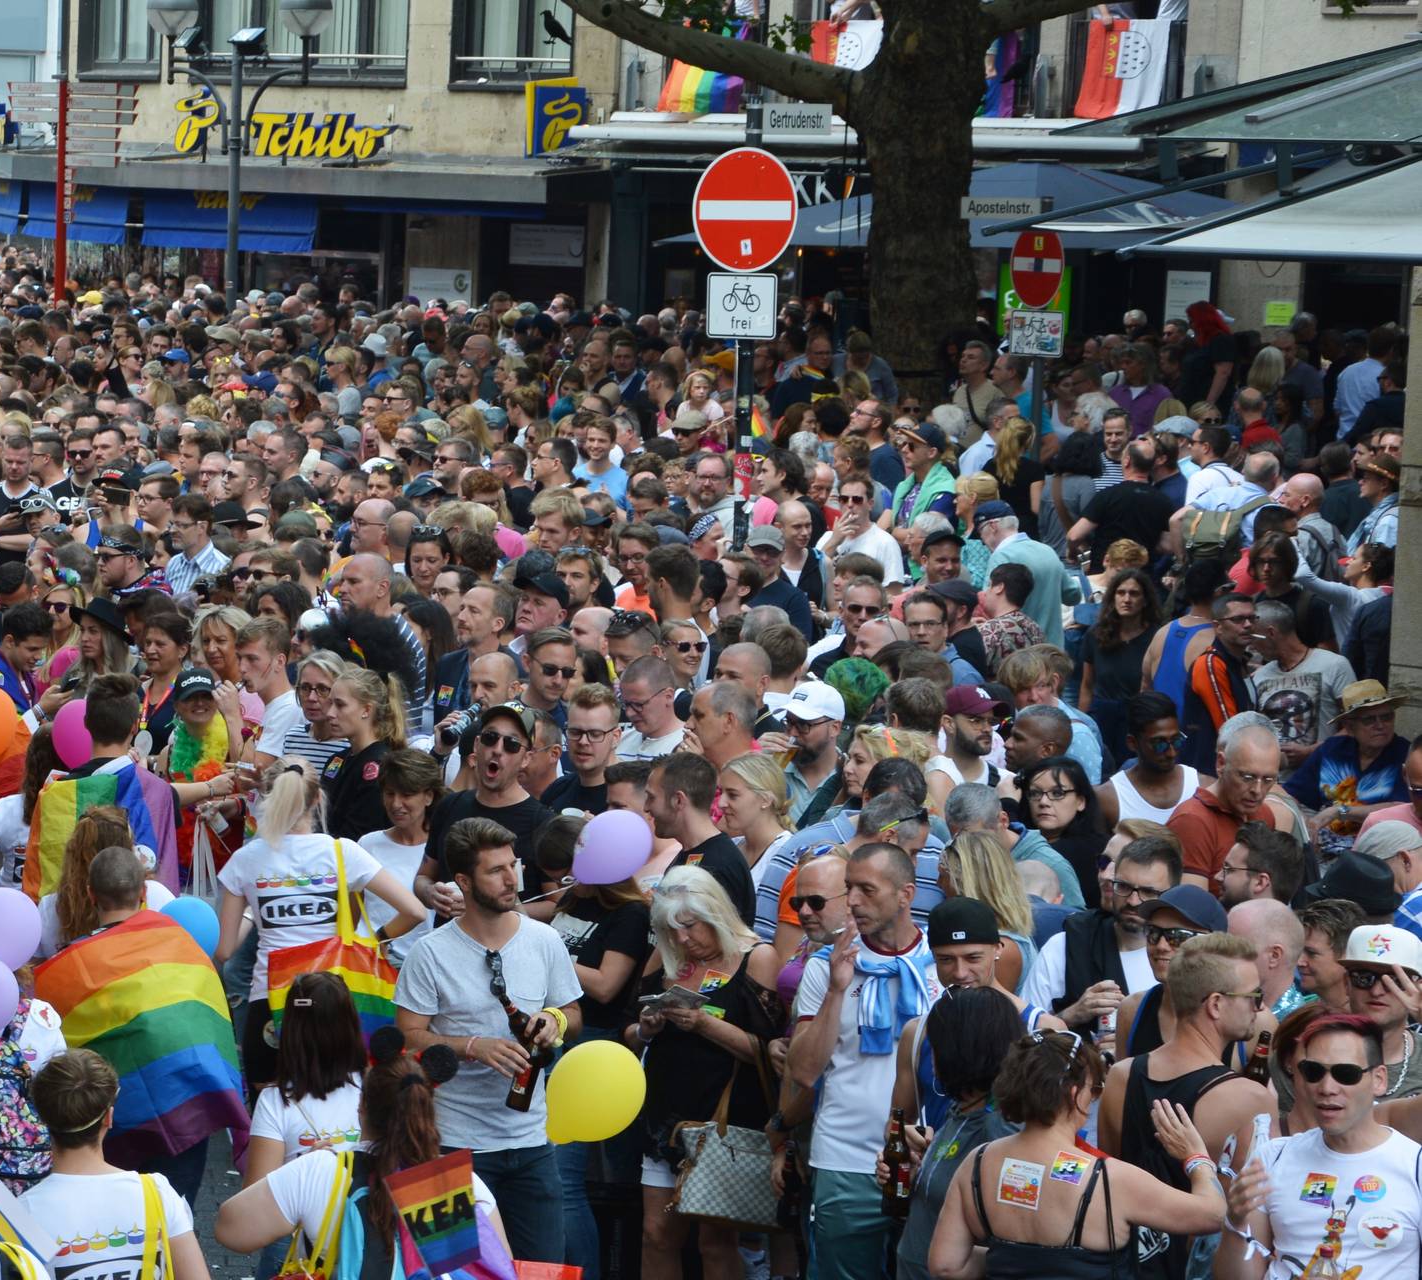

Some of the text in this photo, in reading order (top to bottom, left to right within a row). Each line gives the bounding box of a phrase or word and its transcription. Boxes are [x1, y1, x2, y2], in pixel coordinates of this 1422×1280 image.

[770, 110, 825, 129] Gertrudenstr.
[250, 111, 390, 159] Tchibo
[967, 200, 1033, 215] Apostelnstr.
[731, 316, 751, 329] frei
[56, 496, 83, 511] GE
[181, 675, 212, 688] adidas
[266, 901, 335, 919] IKEA
[1059, 1160, 1077, 1173] FC
[1308, 1181, 1326, 1196] FC
[1361, 1181, 1378, 1194] TOP
